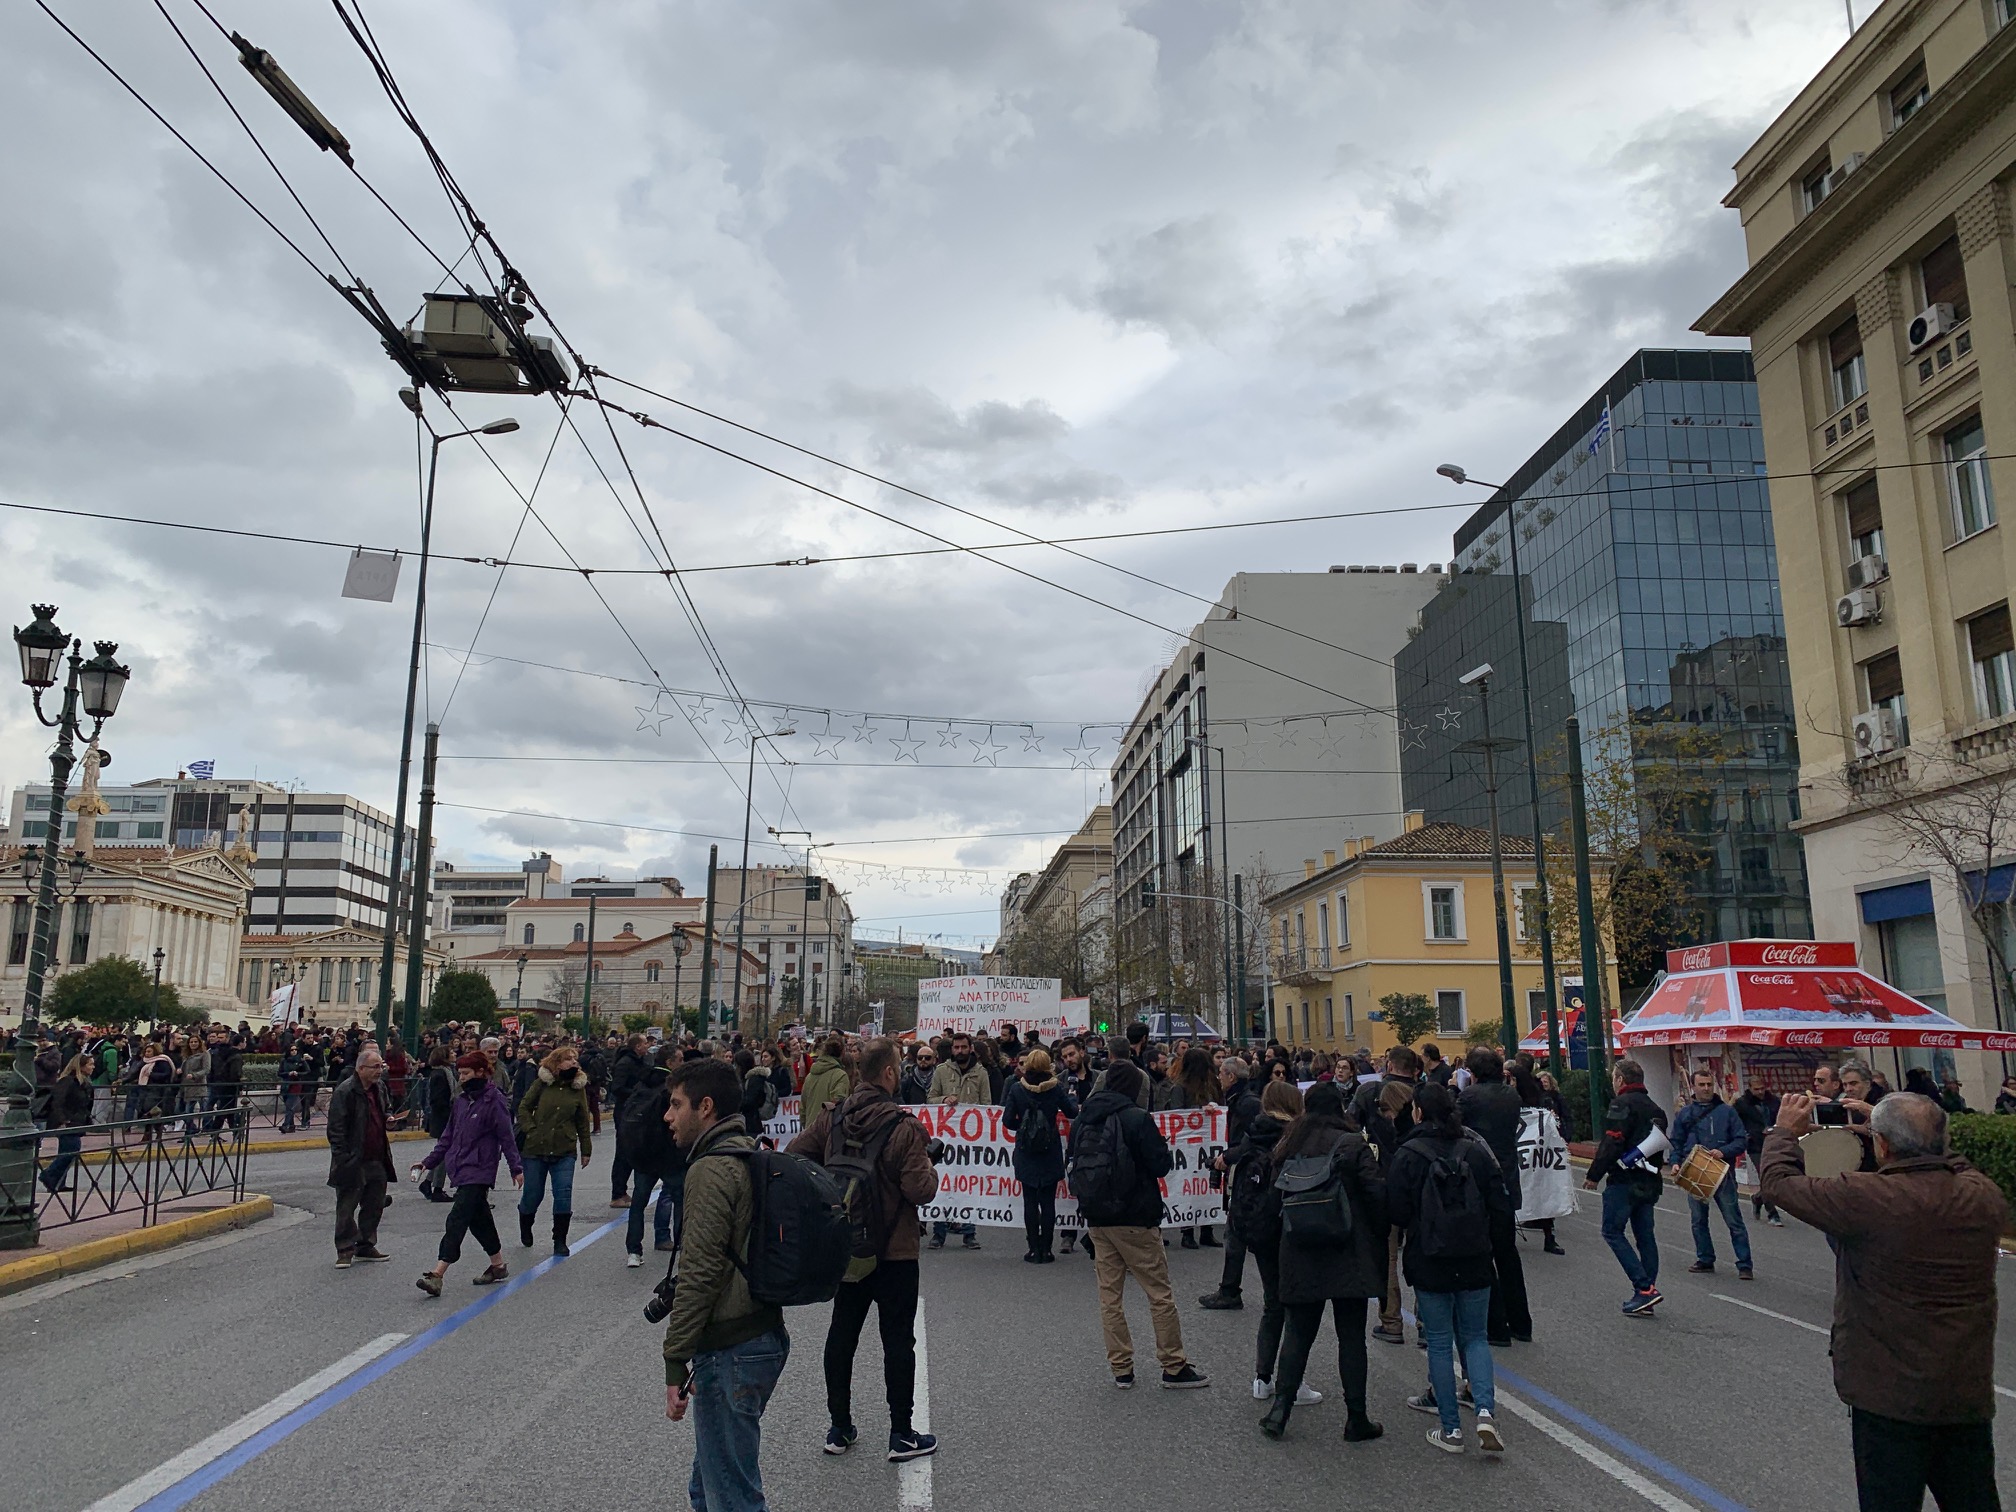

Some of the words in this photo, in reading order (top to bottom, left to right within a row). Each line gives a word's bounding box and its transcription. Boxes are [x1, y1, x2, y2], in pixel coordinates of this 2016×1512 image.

[1682, 947, 1711, 971] Coca-Cola
[1761, 944, 1819, 965] Coca-Cola
[961, 977, 978, 987] ΓΙΑ
[1750, 974, 1794, 985] Coca-Cola
[958, 991, 1030, 1004] ΑΝΑΤΡΟΠΗΣ
[1786, 1031, 1824, 1044] Coca-Cola
[1853, 1030, 1891, 1044] Coca-Cola
[1920, 1032, 1957, 1046] Coca-Cola
